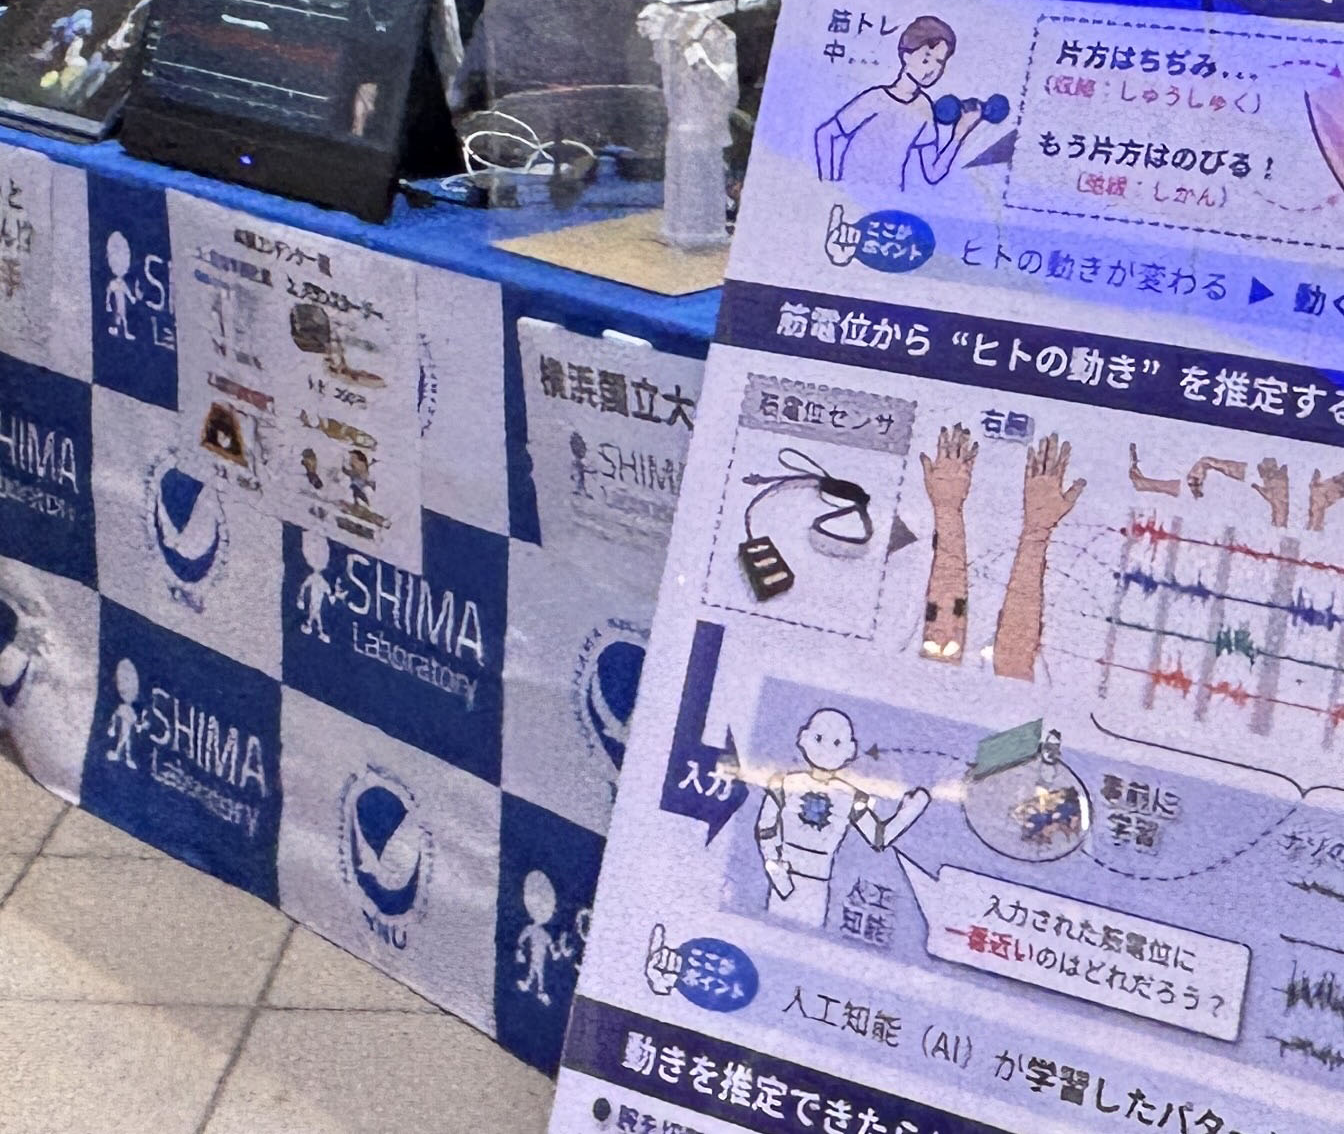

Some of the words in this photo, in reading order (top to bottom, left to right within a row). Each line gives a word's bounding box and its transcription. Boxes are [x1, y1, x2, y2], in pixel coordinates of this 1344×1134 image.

[347, 553, 485, 667] SHIMA
[150, 688, 267, 798] SHIMA
[678, 761, 734, 801] 入力
